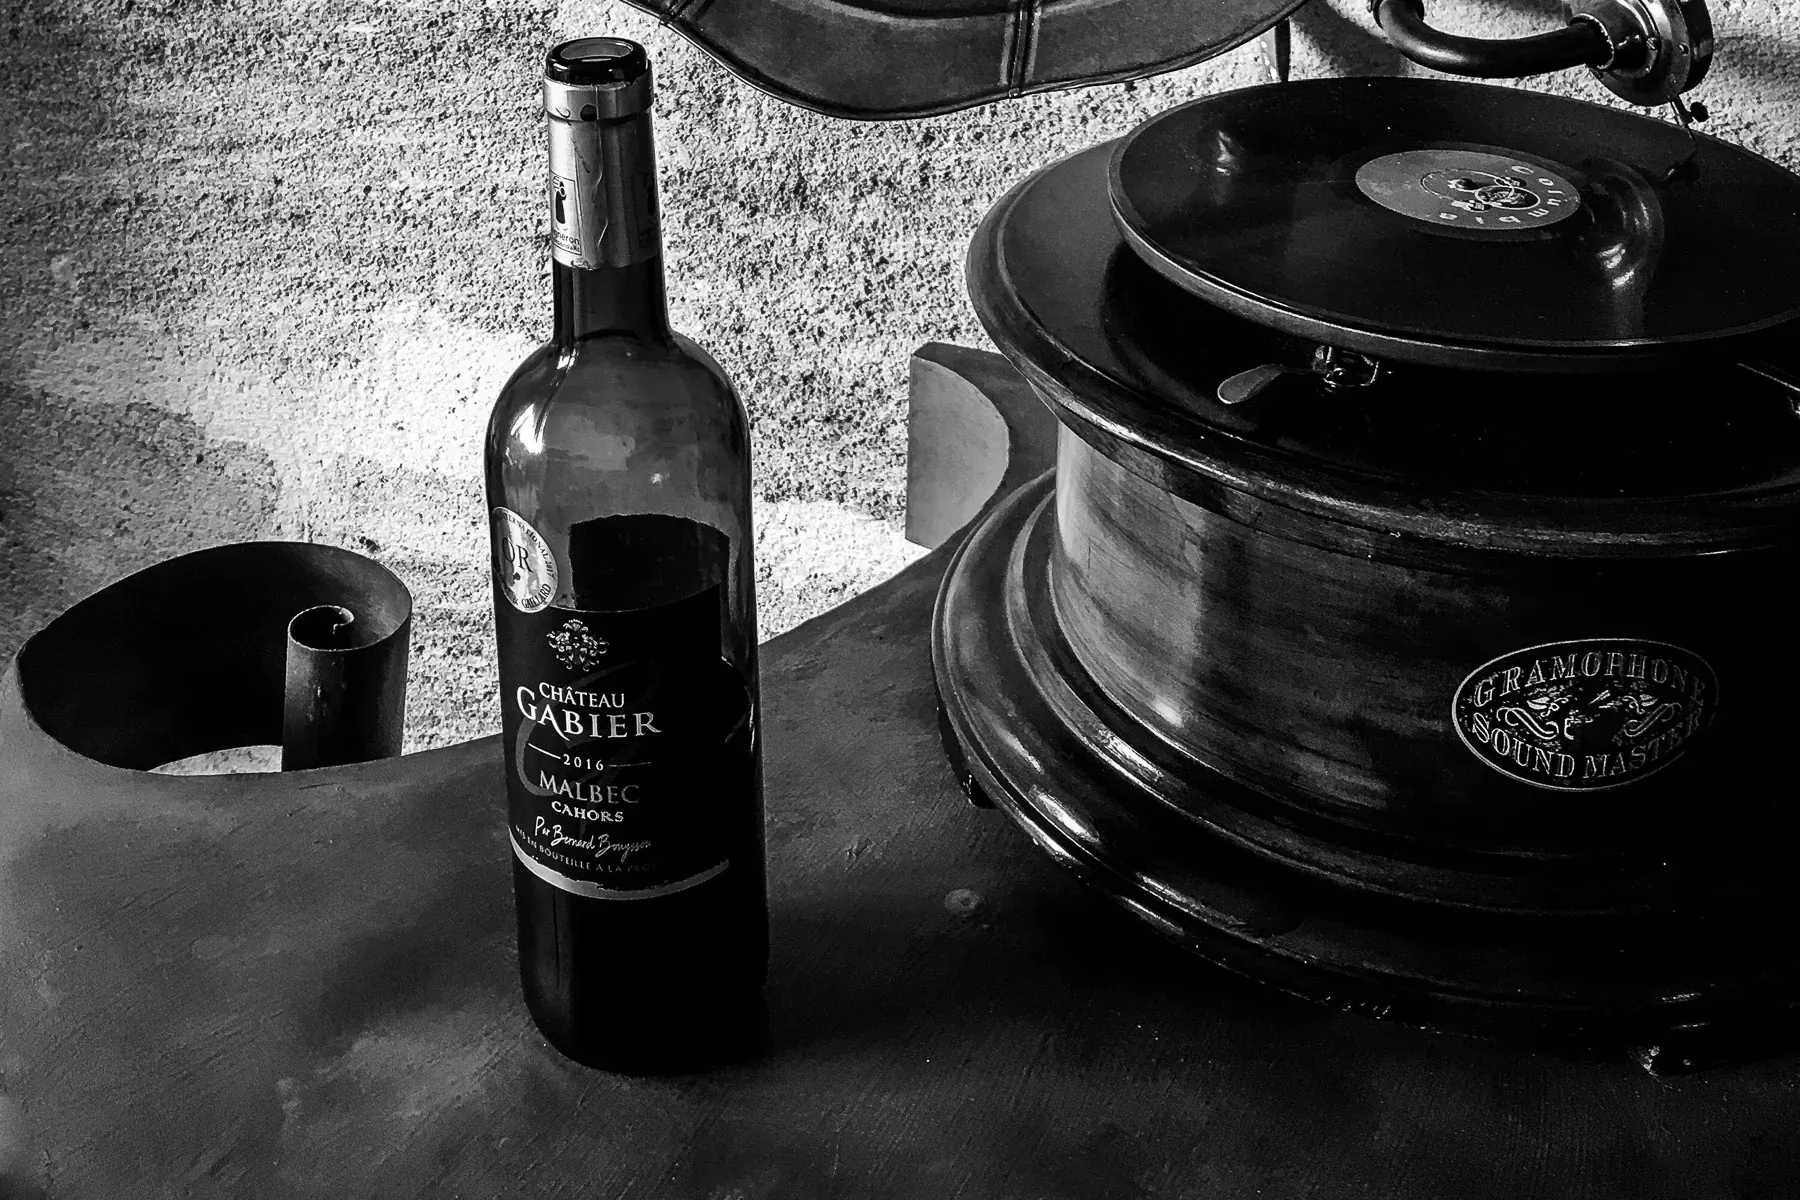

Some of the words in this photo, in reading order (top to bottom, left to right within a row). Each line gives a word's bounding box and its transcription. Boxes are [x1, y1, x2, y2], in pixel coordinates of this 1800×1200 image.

[501, 536, 534, 574] OR
[521, 583, 552, 609] GAILLARD
[538, 681, 626, 709] CHÂTEAU
[1472, 650, 1705, 708] GRAMOPHONE
[516, 685, 664, 742] GABIER
[562, 753, 605, 772] 2016
[1471, 711, 1576, 780] SOUND
[539, 769, 641, 805] MALBEC
[550, 800, 625, 823] CAHORS
[534, 815, 551, 837] Par
[550, 824, 596, 850] Bernard
[538, 844, 592, 871] BOUTEILLE
